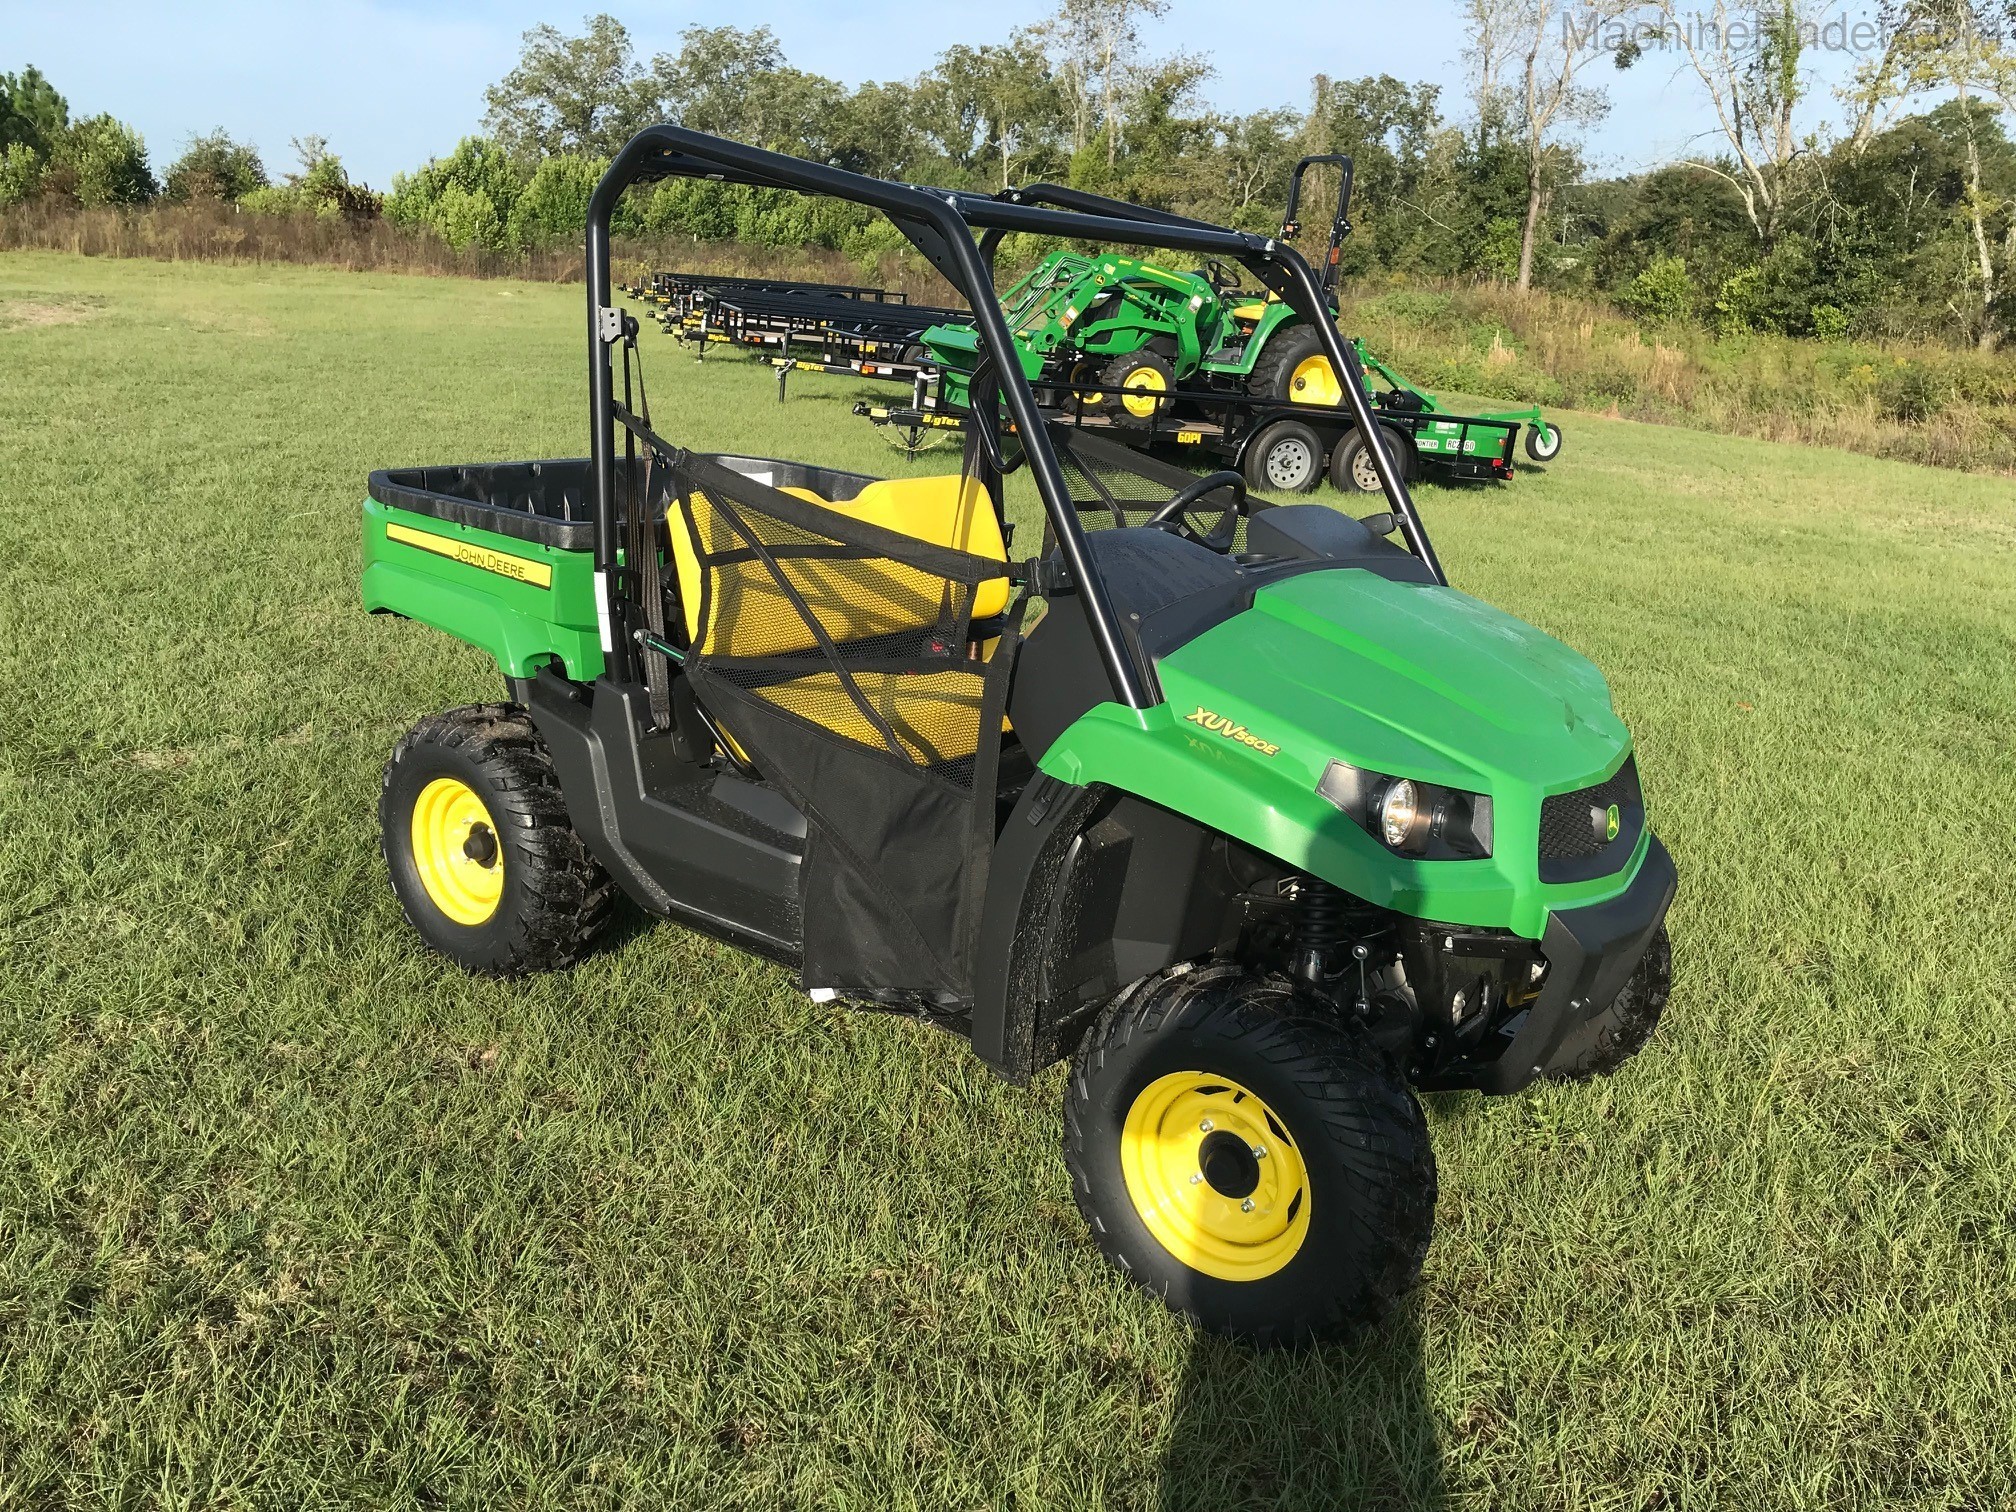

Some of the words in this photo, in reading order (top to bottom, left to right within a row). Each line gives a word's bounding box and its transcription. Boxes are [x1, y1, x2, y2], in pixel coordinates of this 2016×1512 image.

[796, 361, 825, 372] BigTex
[923, 414, 960, 426] BigTex
[1447, 439, 1475, 451] RC260
[454, 545, 485, 565] JOHN
[487, 554, 525, 579] DEERE
[1183, 706, 1281, 757] XUV560E
